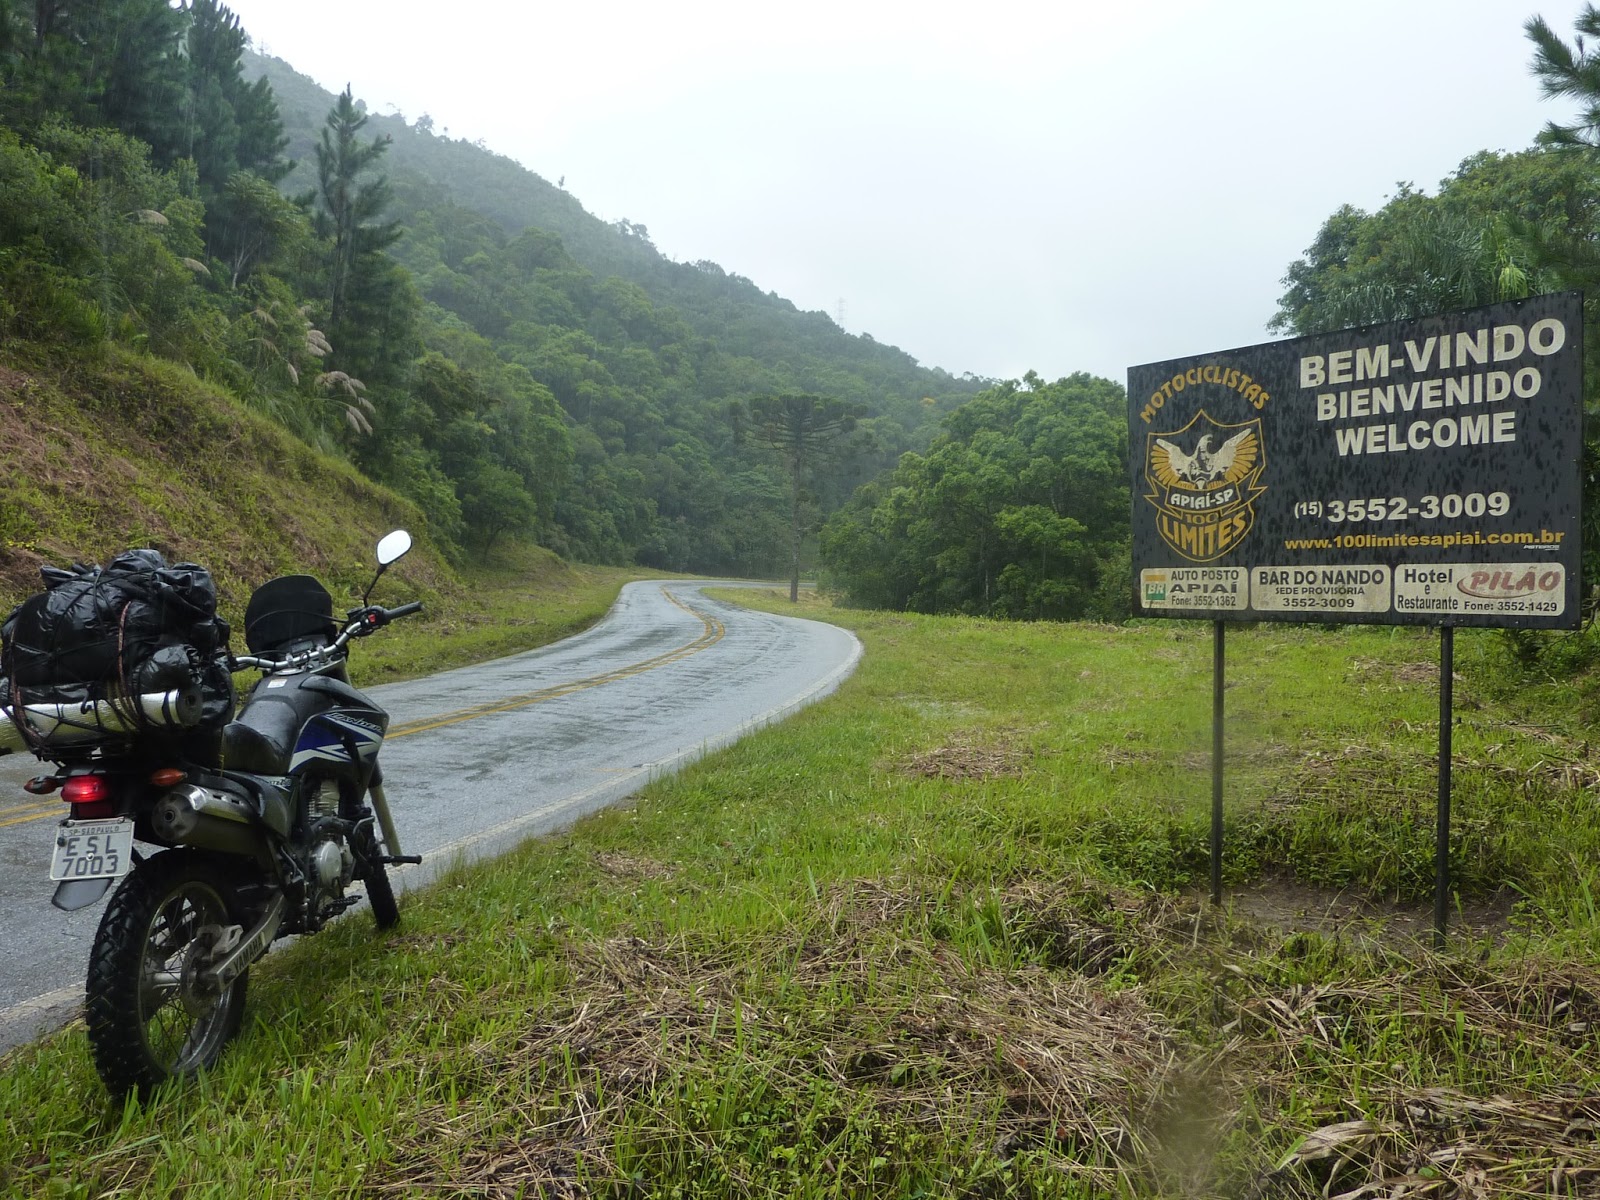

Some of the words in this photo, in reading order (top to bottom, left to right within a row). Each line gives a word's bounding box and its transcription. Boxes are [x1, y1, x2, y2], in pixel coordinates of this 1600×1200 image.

[1300, 318, 1566, 388] BEM-VINDO
[1140, 366, 1270, 424] MOTOCICLISTAS
[1317, 367, 1541, 421] BIENVENIDO
[1336, 411, 1516, 456] WELCOME
[1294, 501, 1323, 519] (15)
[1327, 491, 1511, 522] 3552-3009
[1186, 512, 1219, 525] 100
[1162, 510, 1246, 556] LIMITES
[1285, 529, 1565, 549] www.100limitesapiai.com.br
[1171, 570, 1198, 581] AUTO
[1201, 569, 1239, 581] POSTO
[1259, 571, 1290, 585] BAR
[1294, 570, 1318, 585] DO
[1322, 569, 1385, 585] NANDO
[1404, 568, 1453, 583] Hotel
[1470, 566, 1561, 591] PILÃO
[1147, 583, 1165, 595] BR
[1169, 582, 1238, 593] APIAÍ
[1275, 587, 1299, 595] SEDE
[1301, 585, 1365, 595] PROVISÓRIA
[1424, 584, 1431, 595] e
[1171, 595, 1192, 606] Fone:
[1193, 595, 1236, 607] 3552-1362
[1282, 598, 1355, 608] 3552-3009
[1397, 594, 1459, 610] Restaurante
[1464, 601, 1494, 611] Fone:
[1497, 601, 1558, 612] 3552-1429
[66, 835, 117, 856] ESL
[62, 854, 119, 876] 7003
